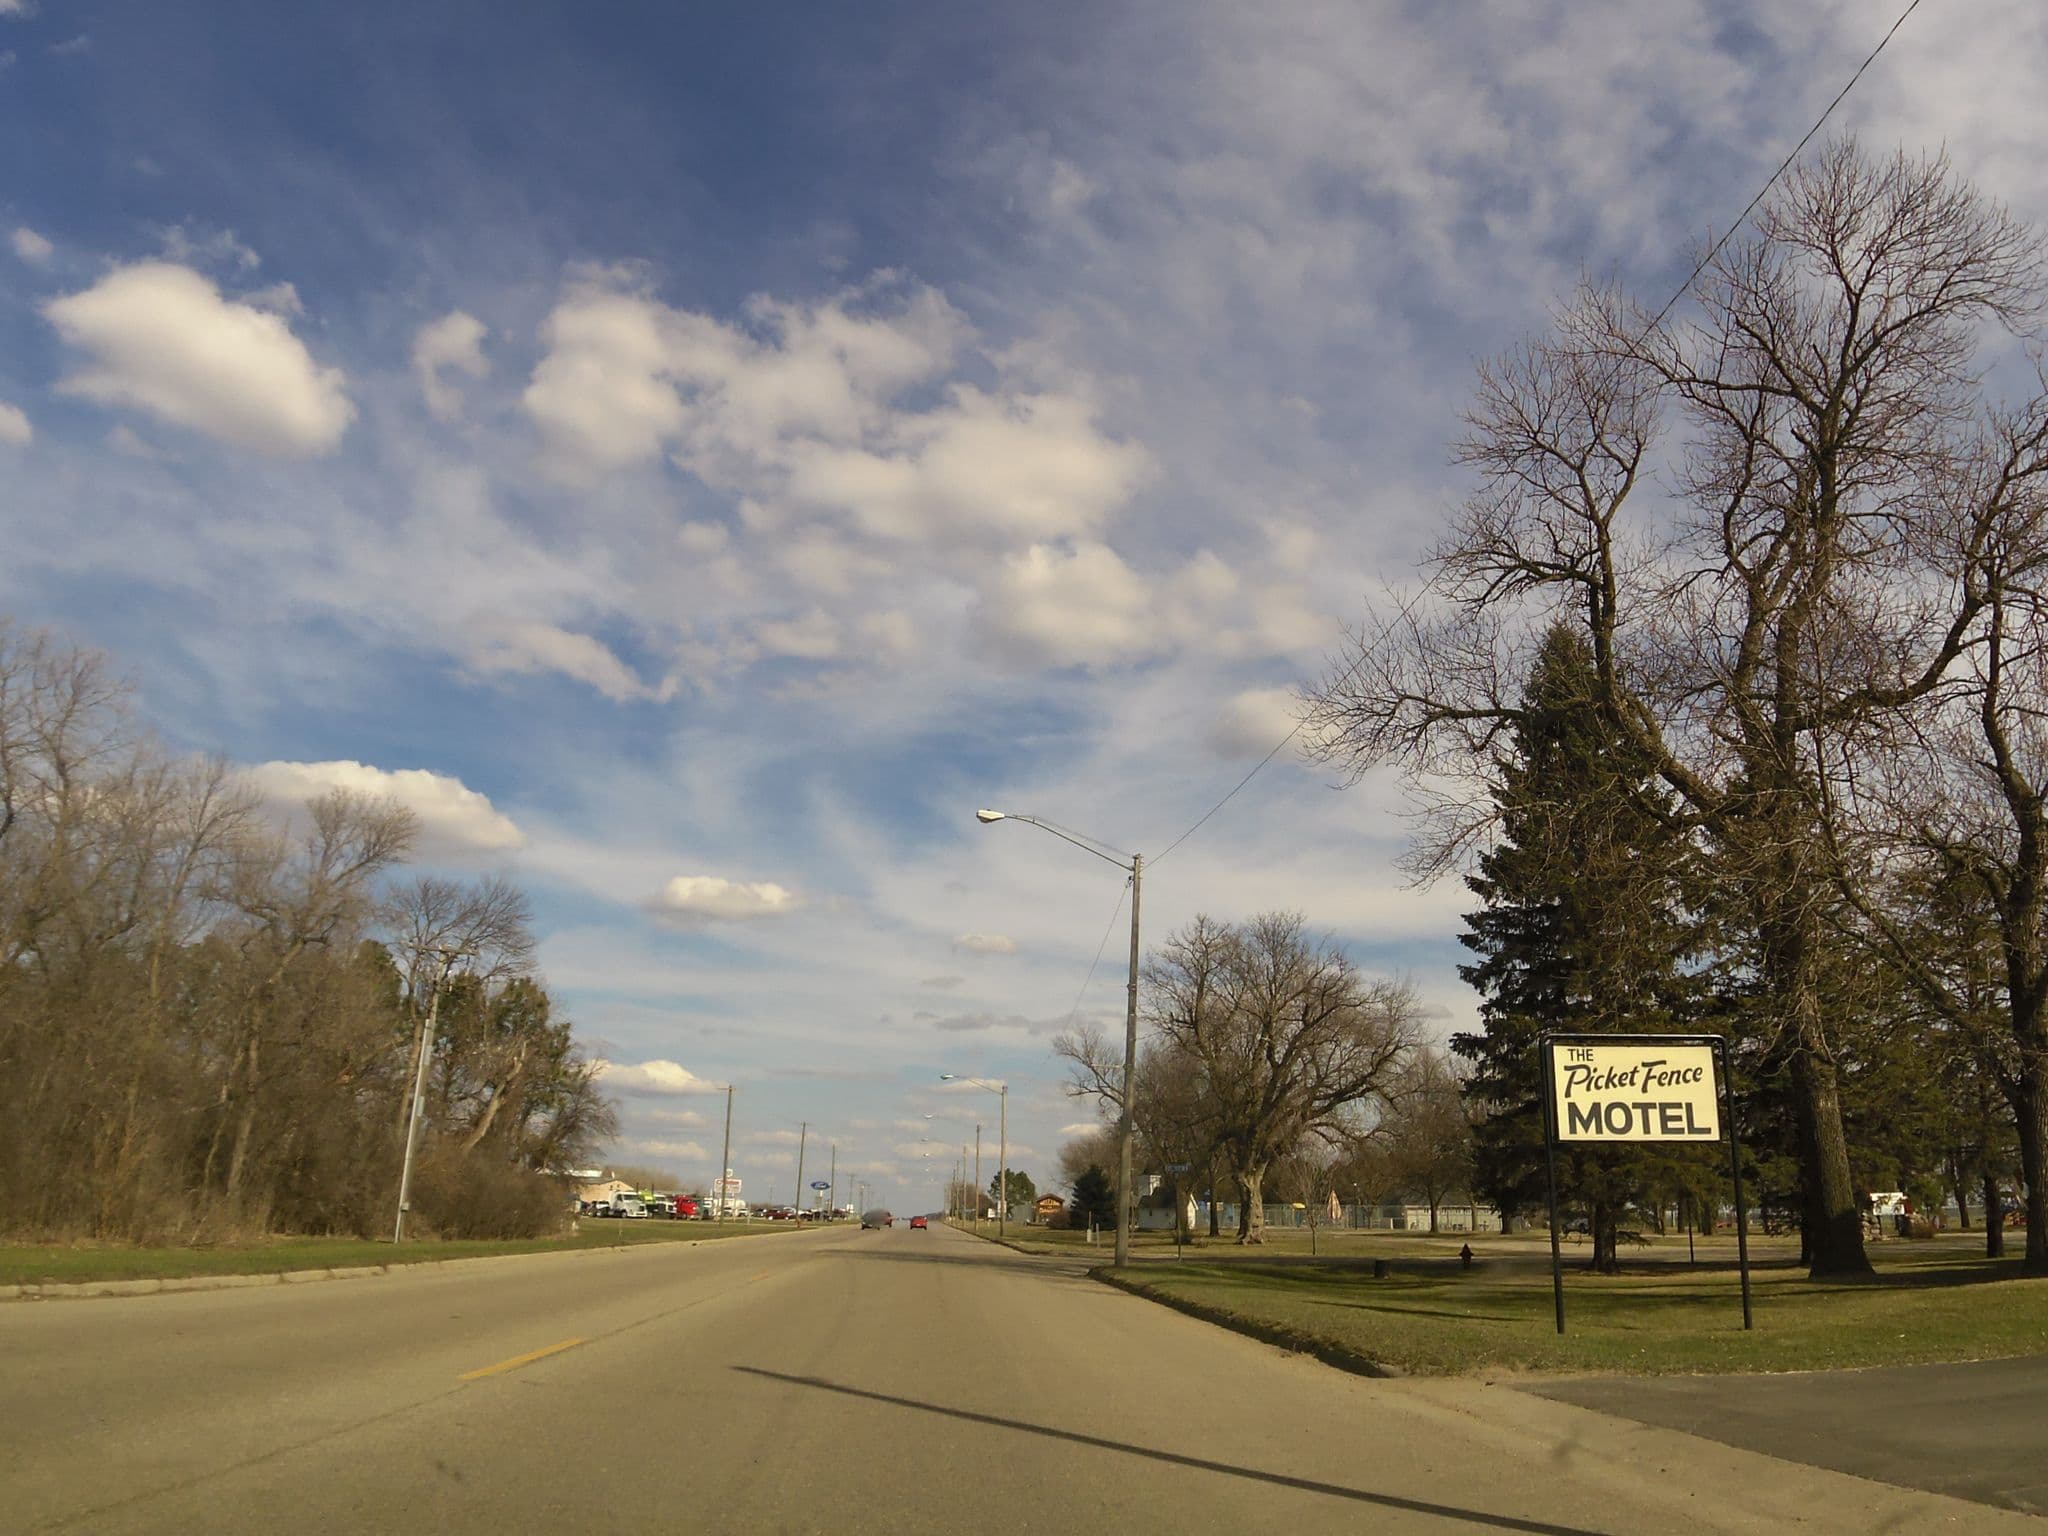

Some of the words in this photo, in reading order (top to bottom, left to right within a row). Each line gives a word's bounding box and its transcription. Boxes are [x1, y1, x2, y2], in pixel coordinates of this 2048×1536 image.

[1567, 1048, 1594, 1062] THE
[1563, 1064, 1640, 1098] Picket
[1641, 1060, 1703, 1094] Fence
[1567, 1101, 1712, 1135] MOTEL
